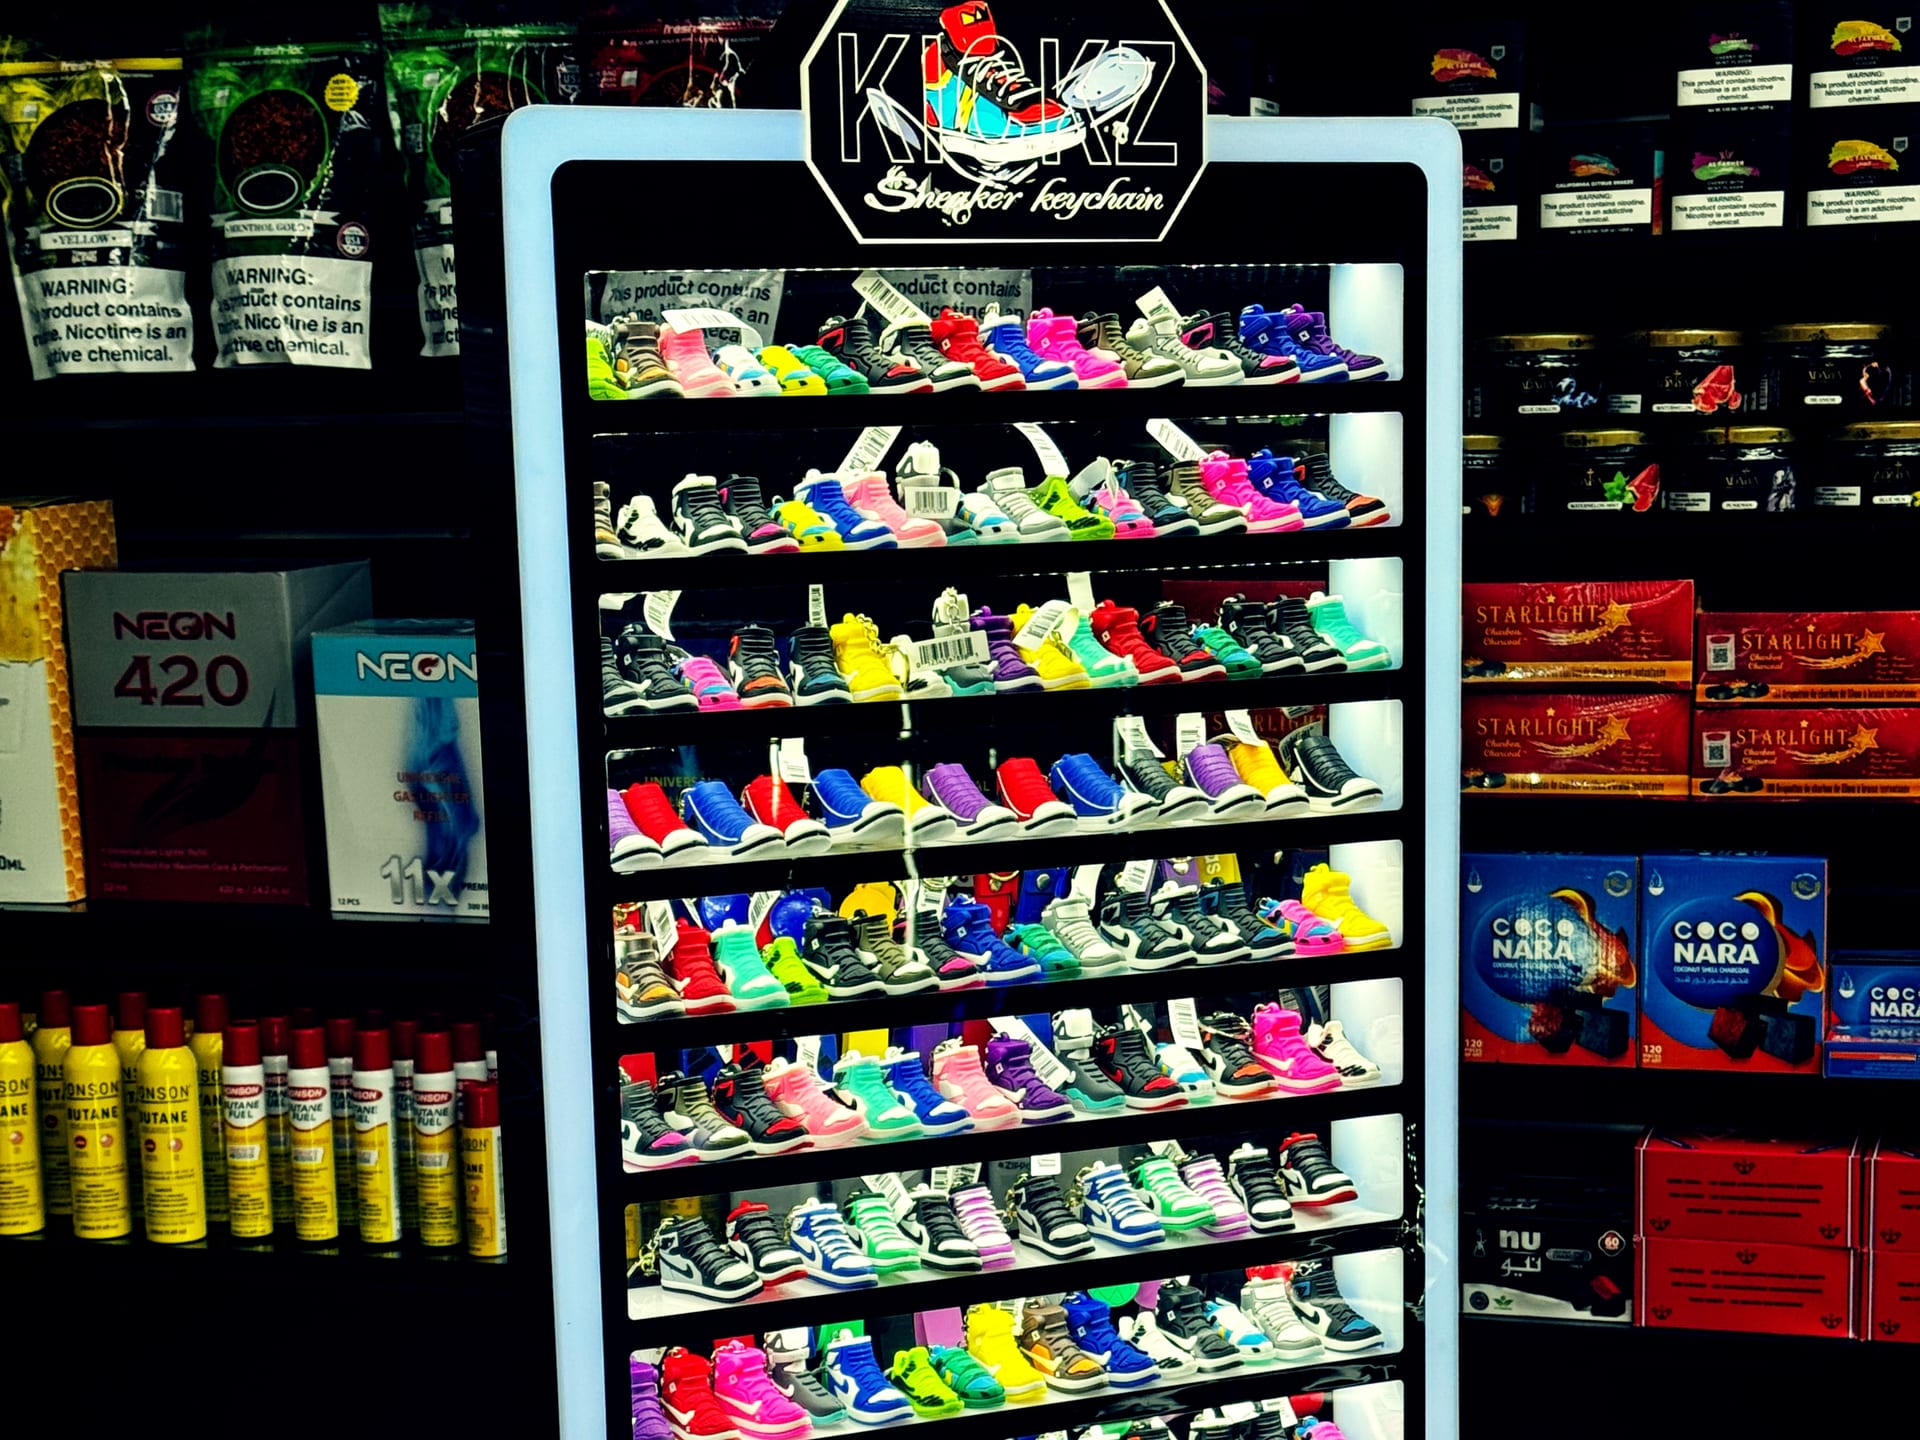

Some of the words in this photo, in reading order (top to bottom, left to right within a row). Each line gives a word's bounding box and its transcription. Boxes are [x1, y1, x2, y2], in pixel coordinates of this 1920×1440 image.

[1697, 79, 1725, 88] product
[1828, 80, 1857, 89] product
[1825, 88, 1855, 96] Nicotine
[1429, 106, 1455, 115] product
[863, 174, 1024, 214] Sneaker
[1029, 176, 1164, 220] keychain
[1826, 199, 1854, 208] product
[1558, 202, 1585, 210] product
[1689, 204, 1716, 212] product
[1717, 202, 1747, 210] contains
[1871, 204, 1904, 212] addictive
[1685, 212, 1714, 220] Nicotine
[59, 234, 110, 245] YELLOW
[227, 268, 314, 286] WARNING:
[41, 278, 135, 297] WARNING:
[635, 280, 694, 302] product
[954, 279, 1021, 297] contains
[105, 303, 182, 318] contains
[283, 293, 361, 312] contains
[323, 316, 337, 333] is
[342, 319, 364, 334] an
[748, 309, 770, 325] an
[66, 324, 142, 340] Nicotine
[146, 323, 162, 339] is
[165, 326, 186, 339] an
[88, 345, 173, 362] chemical.
[266, 336, 350, 357] chemical.
[1476, 603, 1599, 625] STARLIGHT
[112, 611, 237, 642] NEON
[1483, 636, 1522, 647] Charcoal
[1742, 632, 1856, 651] STARLIGHT
[356, 650, 479, 682] NEON
[113, 653, 249, 708] 420
[1476, 717, 1598, 737] STARLIGHT
[1735, 728, 1849, 746] STARLIGHT
[1483, 749, 1521, 759] Charcoal
[463, 882, 488, 892] PREMI
[1492, 917, 1575, 938] COCO
[1673, 920, 1761, 942] COCO
[1492, 938, 1576, 961] NARA
[1673, 942, 1761, 965] NARA
[1701, 966, 1718, 974] SHELL
[1719, 966, 1750, 974] CHARCOAL
[1870, 986, 1920, 1001] COC
[1464, 1038, 1484, 1048] 120
[1643, 1045, 1663, 1054] 120
[228, 1110, 254, 1119] FUEL
[292, 1112, 317, 1122] FUEL
[417, 1117, 442, 1127] FUEL
[1499, 1229, 1542, 1251] nu
[1603, 1238, 1621, 1249] 60
